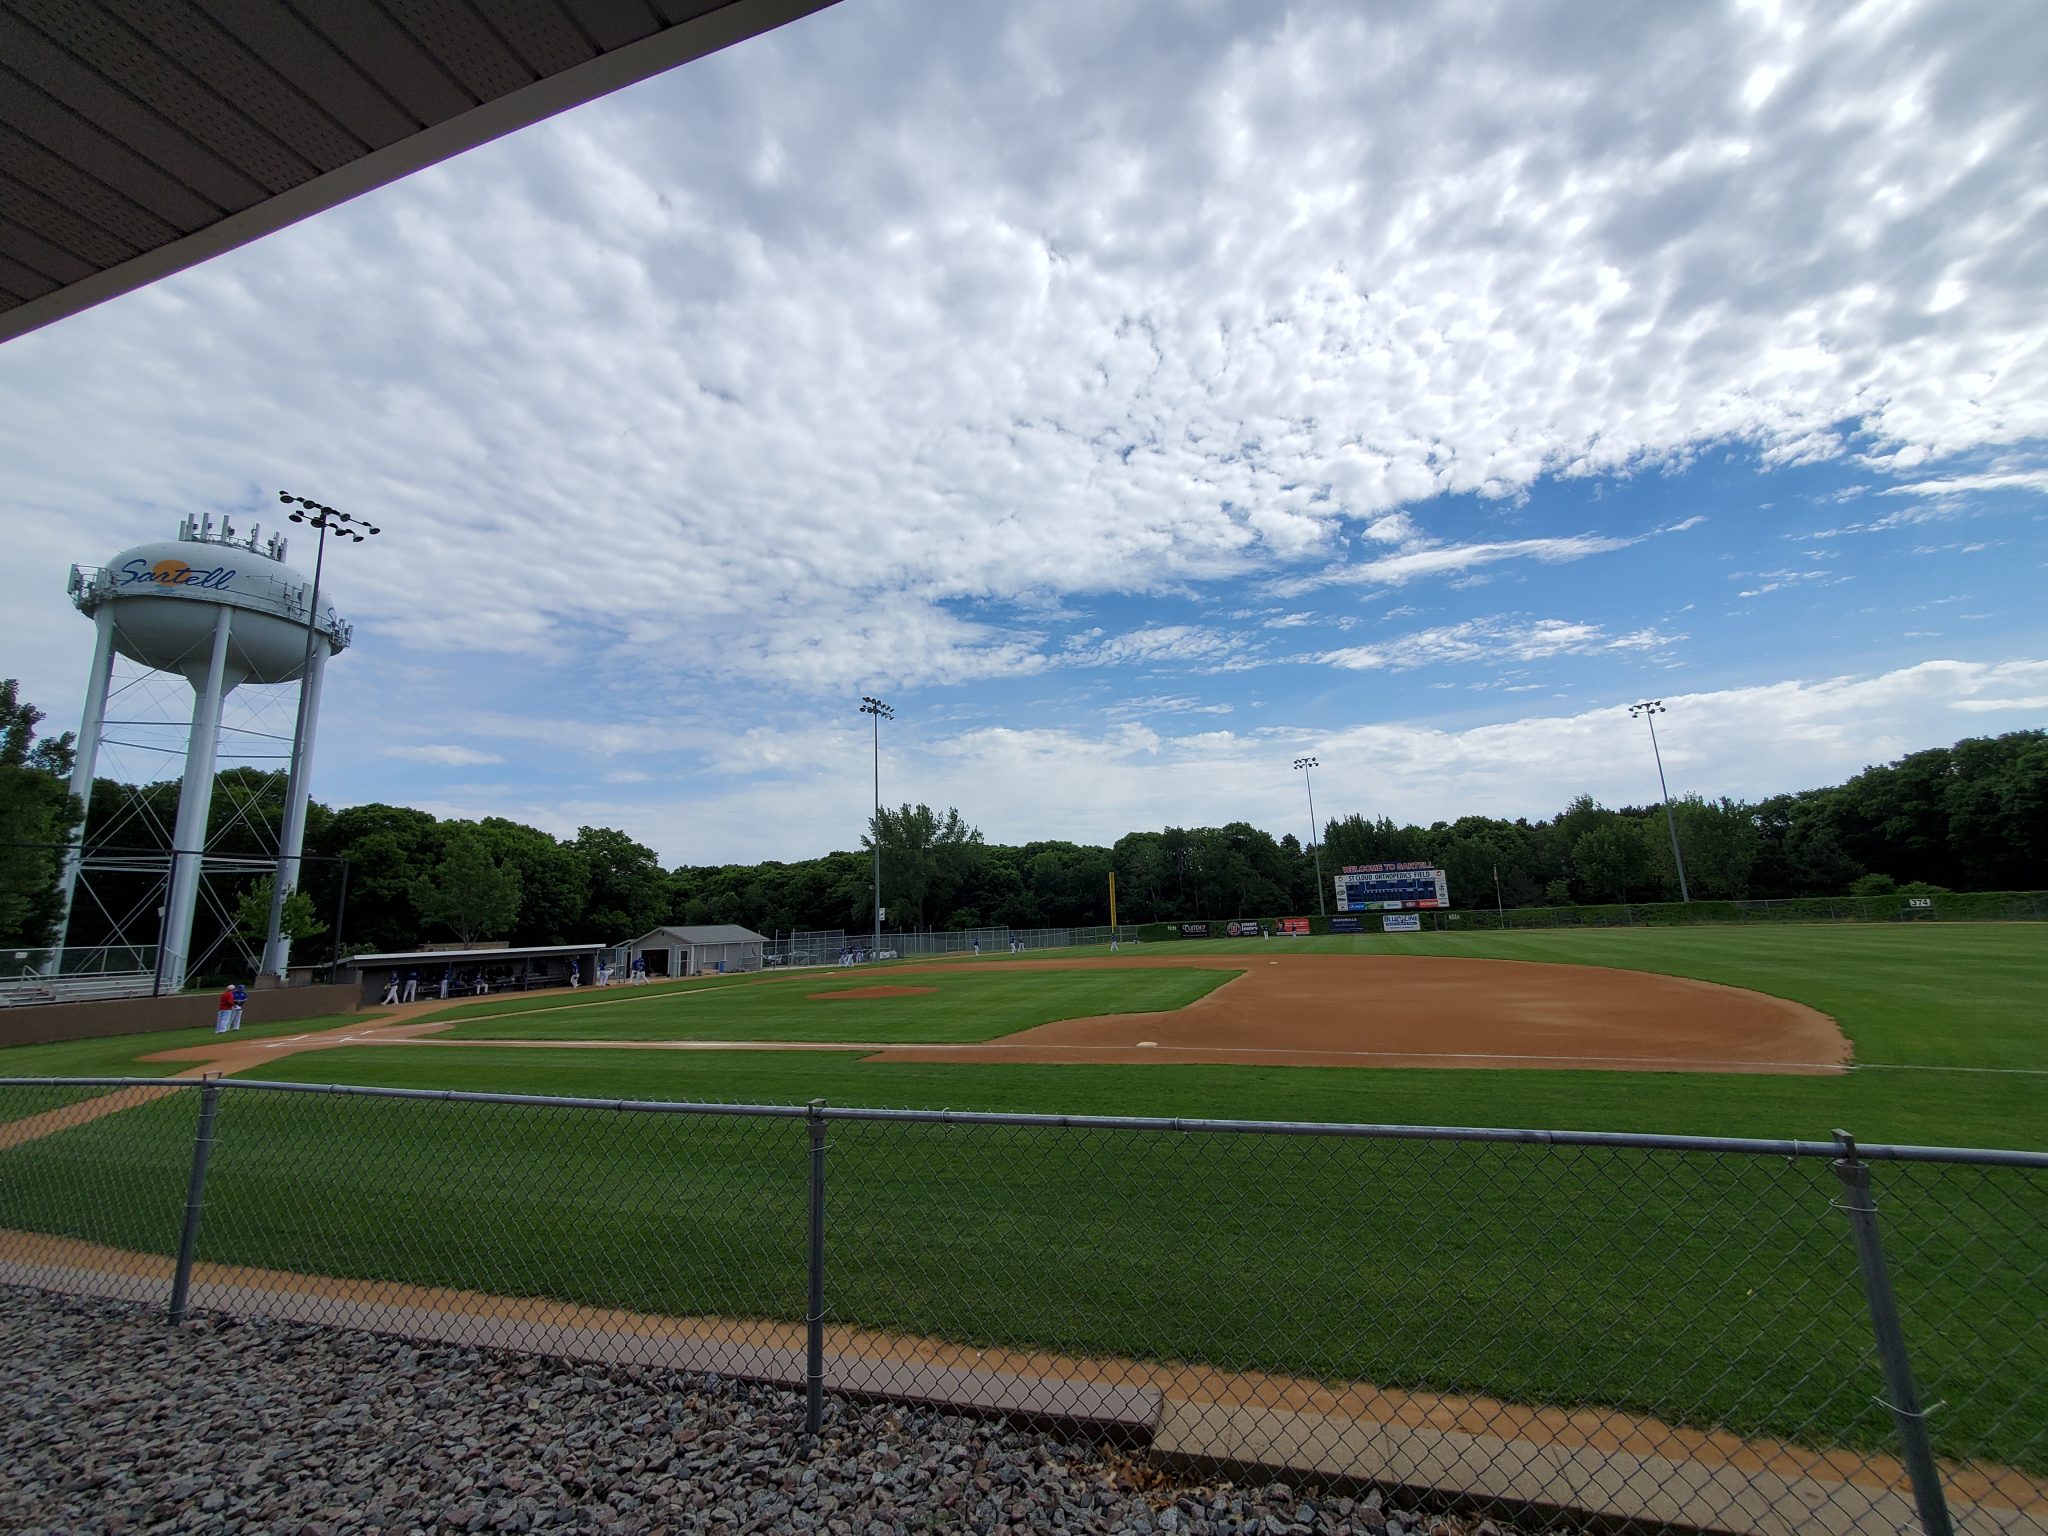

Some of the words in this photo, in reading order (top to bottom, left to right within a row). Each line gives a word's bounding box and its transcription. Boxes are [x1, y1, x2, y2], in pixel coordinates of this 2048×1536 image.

[118, 558, 236, 590] Sartell
[1342, 864, 1383, 874] WELCOME
[1384, 863, 1395, 871] TO
[1398, 861, 1435, 870] SARTELL
[1375, 872, 1412, 880] ORTHOPEDICS
